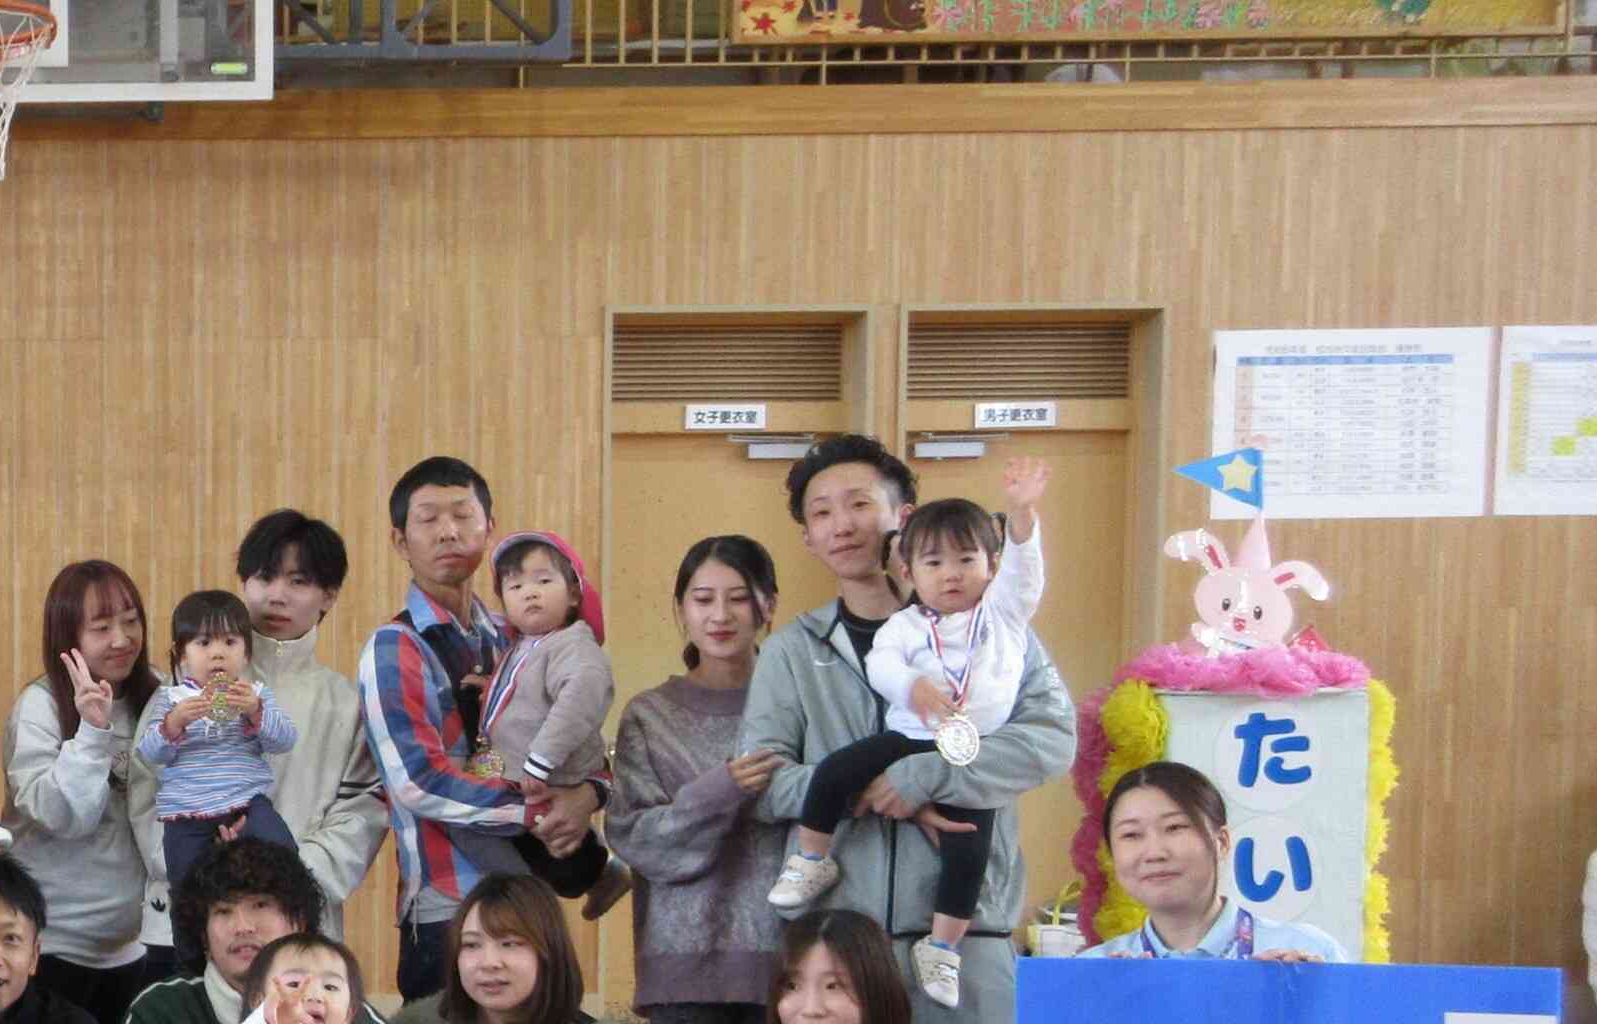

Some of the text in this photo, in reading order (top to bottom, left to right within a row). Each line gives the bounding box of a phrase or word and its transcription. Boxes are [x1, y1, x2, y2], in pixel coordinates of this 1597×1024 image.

[693, 410, 757, 424] 女子更衣室
[983, 407, 1048, 423] 男子更衣室
